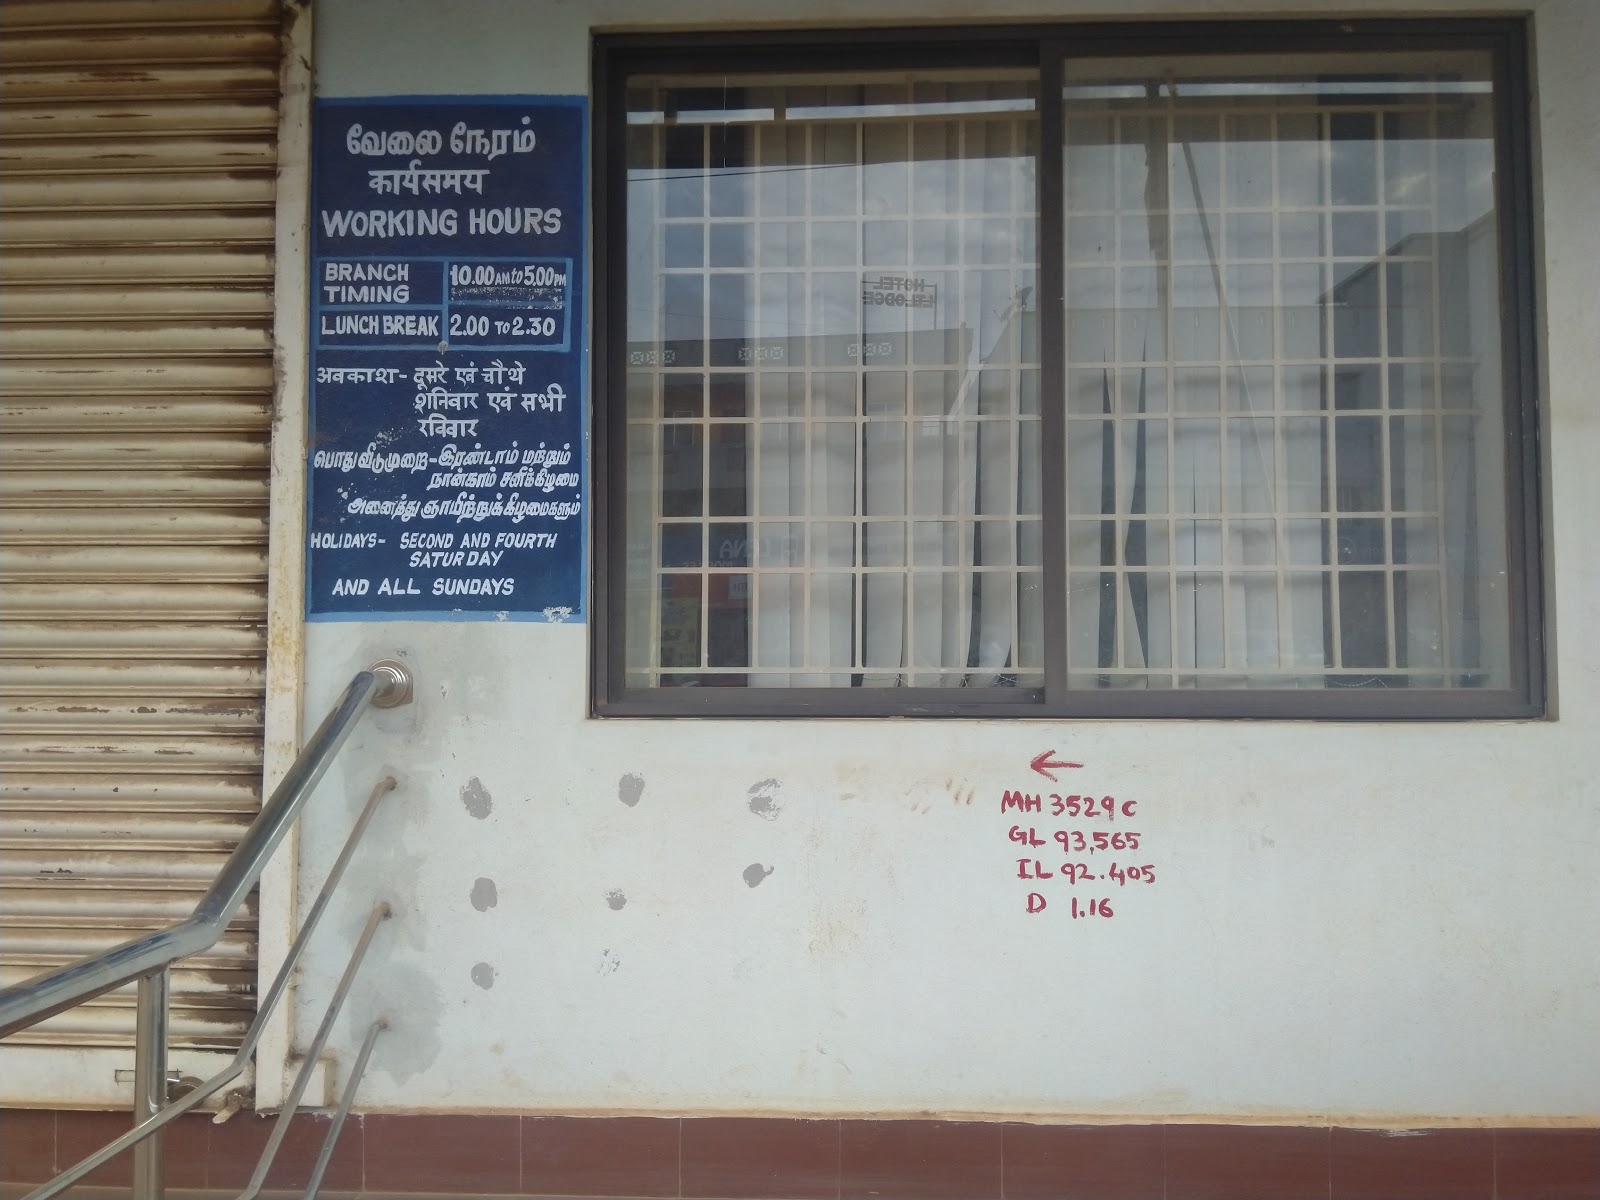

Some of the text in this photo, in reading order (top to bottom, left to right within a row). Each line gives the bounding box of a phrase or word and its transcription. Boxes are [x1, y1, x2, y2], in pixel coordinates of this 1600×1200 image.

[347, 116, 536, 160] வேலை நேரம்
[368, 160, 490, 195] कार्यसमय
[321, 207, 562, 238] WORKING HOURS
[325, 263, 409, 282] BRANCH
[324, 285, 410, 304] TIMING
[321, 315, 439, 337] LUNCH BREAK
[450, 314, 556, 336] 2.00 TO 2.30
[413, 360, 449, 389] दूसरे
[454, 362, 478, 385] एवं
[481, 359, 526, 385] चौथे
[414, 383, 566, 413] शनिवार एवं सभी
[417, 413, 479, 437] रविवार
[347, 494, 421, 522] அனைத்து
[400, 532, 453, 549] SECOND
[460, 532, 491, 548] AND
[495, 532, 558, 550] FOURTH
[331, 577, 515, 596] AND ALL SUNDAYS
[1000, 790, 1042, 815] MH
[1048, 793, 1115, 822] 3529
[1008, 825, 1046, 848] GL
[1060, 862, 1156, 886] 92.405
[1025, 892, 1114, 919] D 1.16
